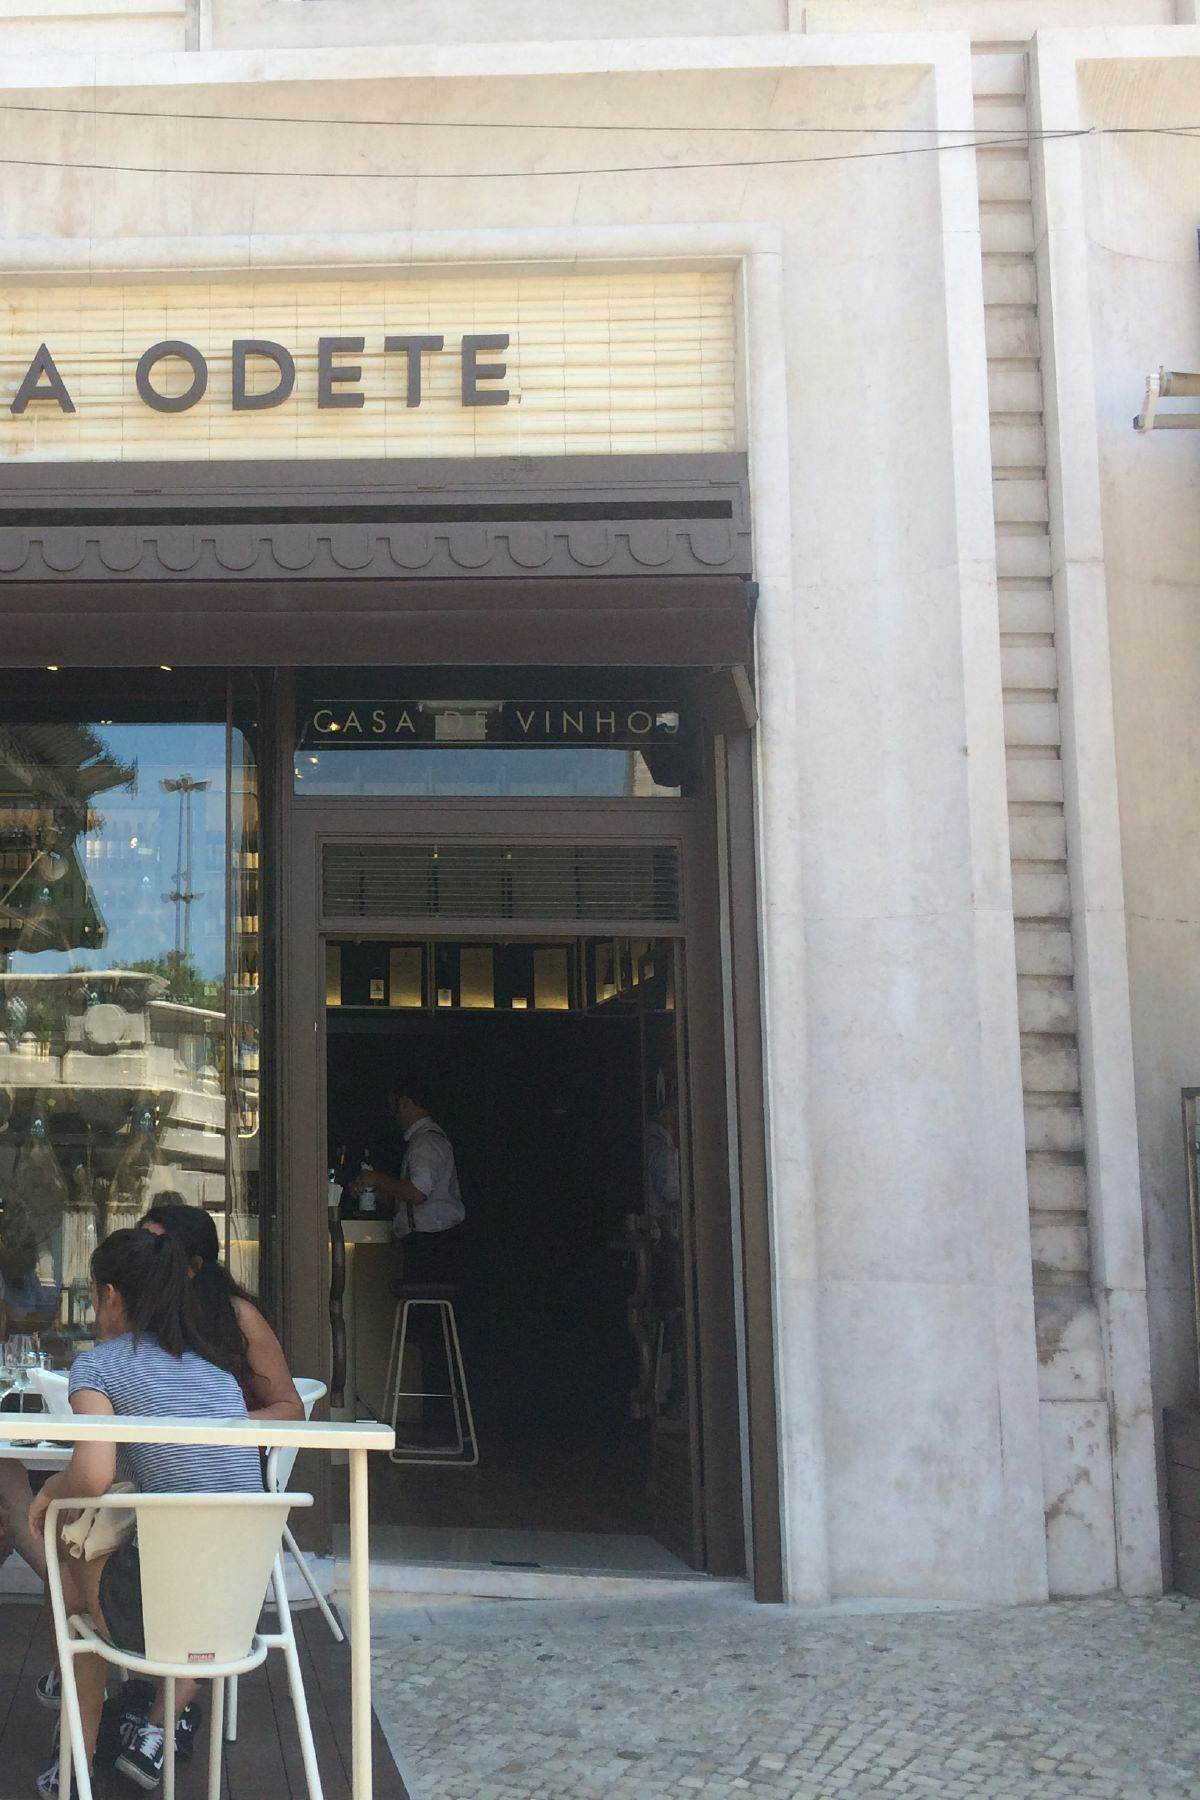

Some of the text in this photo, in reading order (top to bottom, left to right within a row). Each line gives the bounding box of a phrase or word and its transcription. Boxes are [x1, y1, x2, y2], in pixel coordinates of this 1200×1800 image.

[135, 334, 510, 413] ODETE
[313, 709, 416, 734] CASA
[444, 710, 489, 735] DE
